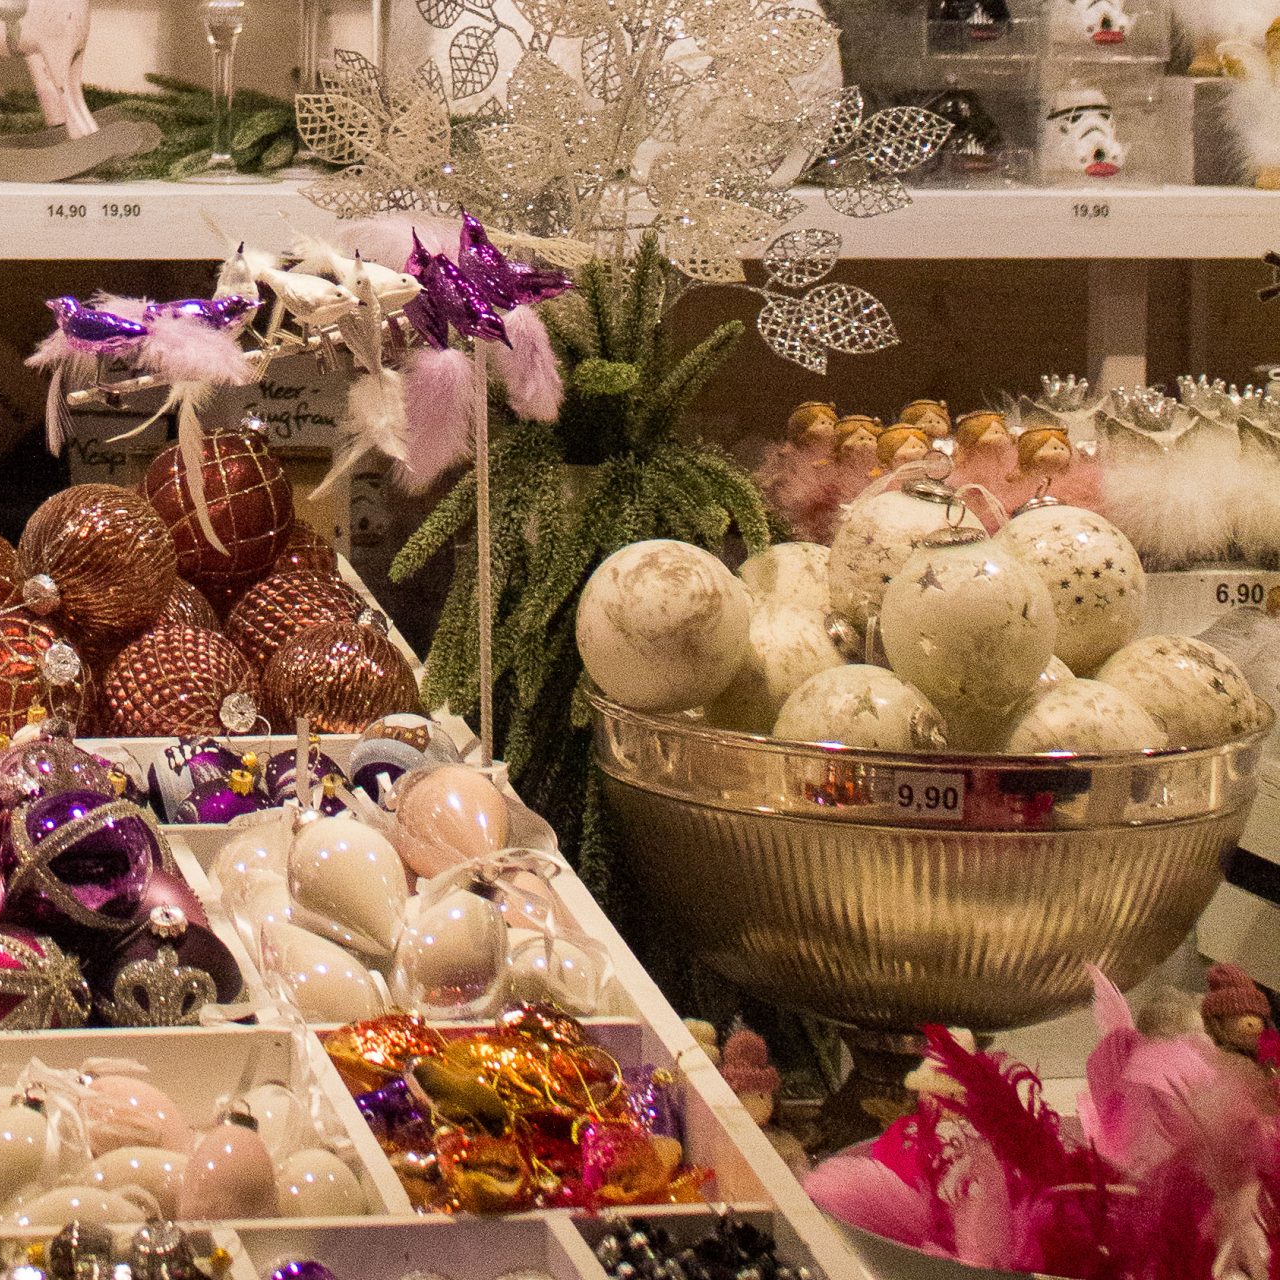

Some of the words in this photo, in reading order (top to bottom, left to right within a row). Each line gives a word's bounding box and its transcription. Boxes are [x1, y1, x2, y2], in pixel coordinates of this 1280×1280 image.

[47, 204, 87, 219] 14,90
[102, 204, 141, 219] 19,90
[1072, 204, 1110, 220] 19,90
[243, 401, 338, 439] ngfrau
[1216, 583, 1264, 607] 6,90
[898, 783, 959, 811] 9,90
